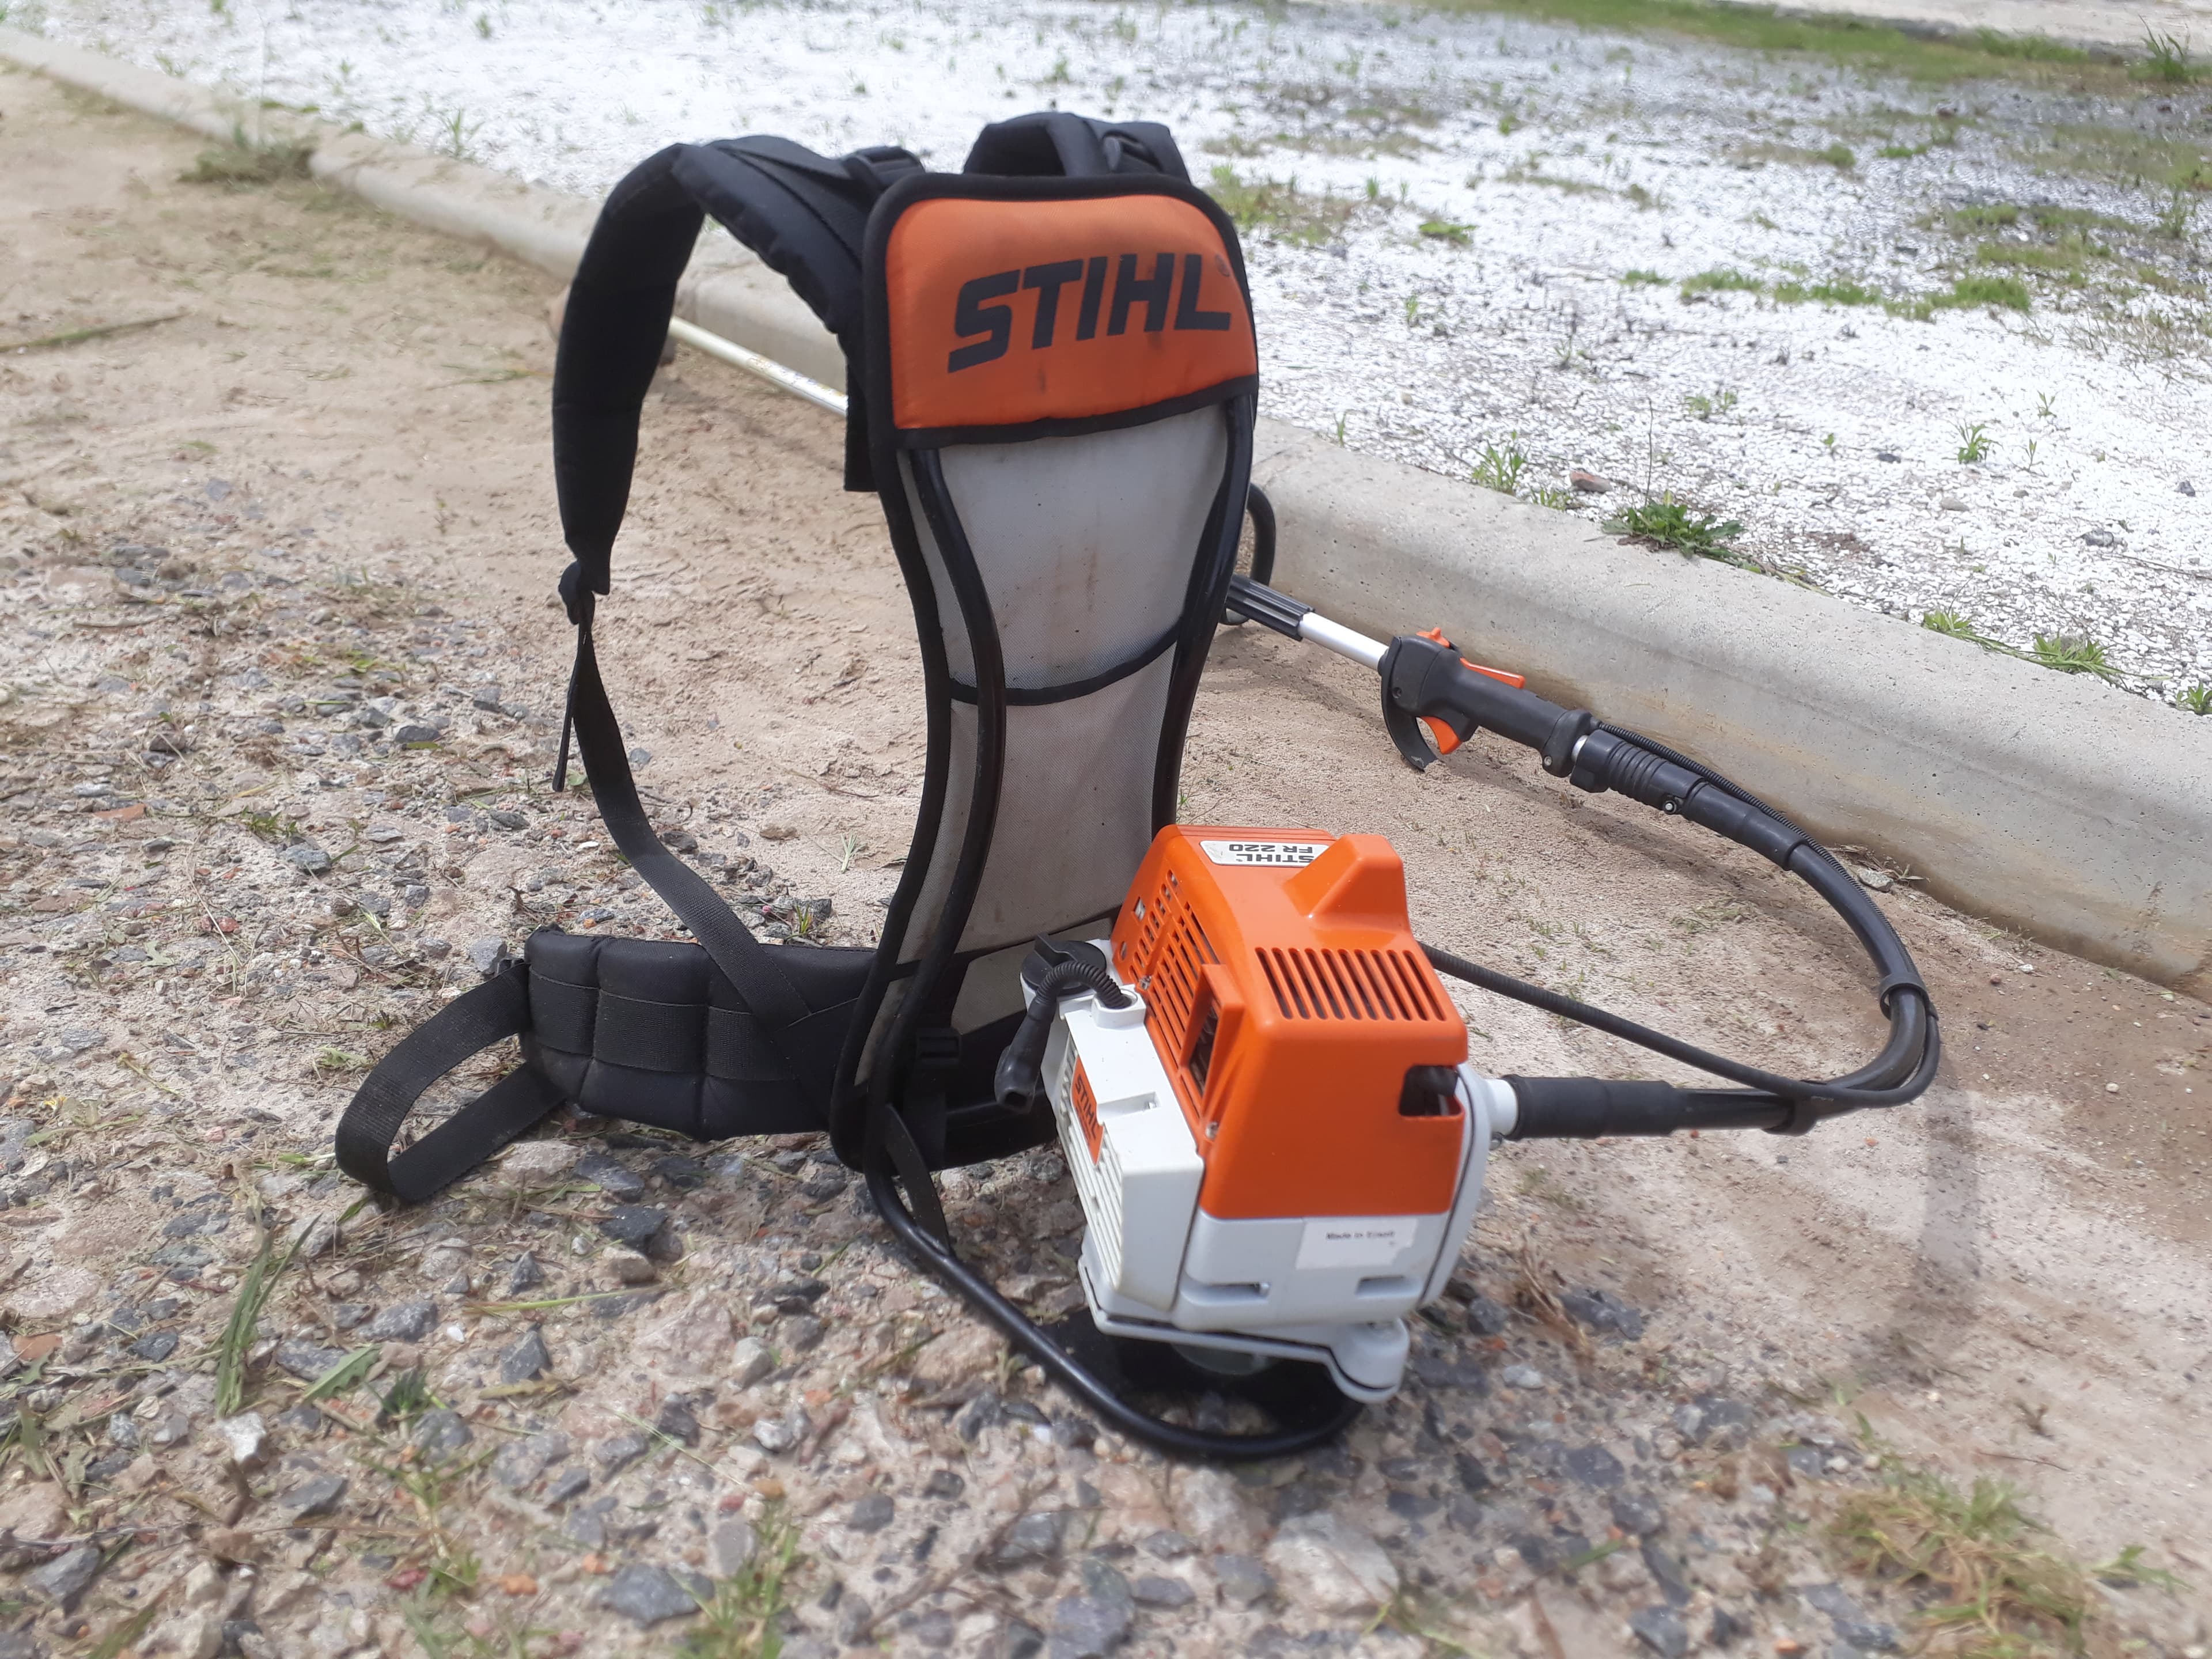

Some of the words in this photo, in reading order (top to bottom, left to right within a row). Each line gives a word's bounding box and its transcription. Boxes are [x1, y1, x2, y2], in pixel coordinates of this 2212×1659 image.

[948, 252, 1231, 373] STIHL
[1229, 844, 1275, 852] 220
[1282, 845, 1313, 854] FR
[1236, 853, 1315, 863] STIHL
[1075, 1074, 1096, 1139] STIHL
